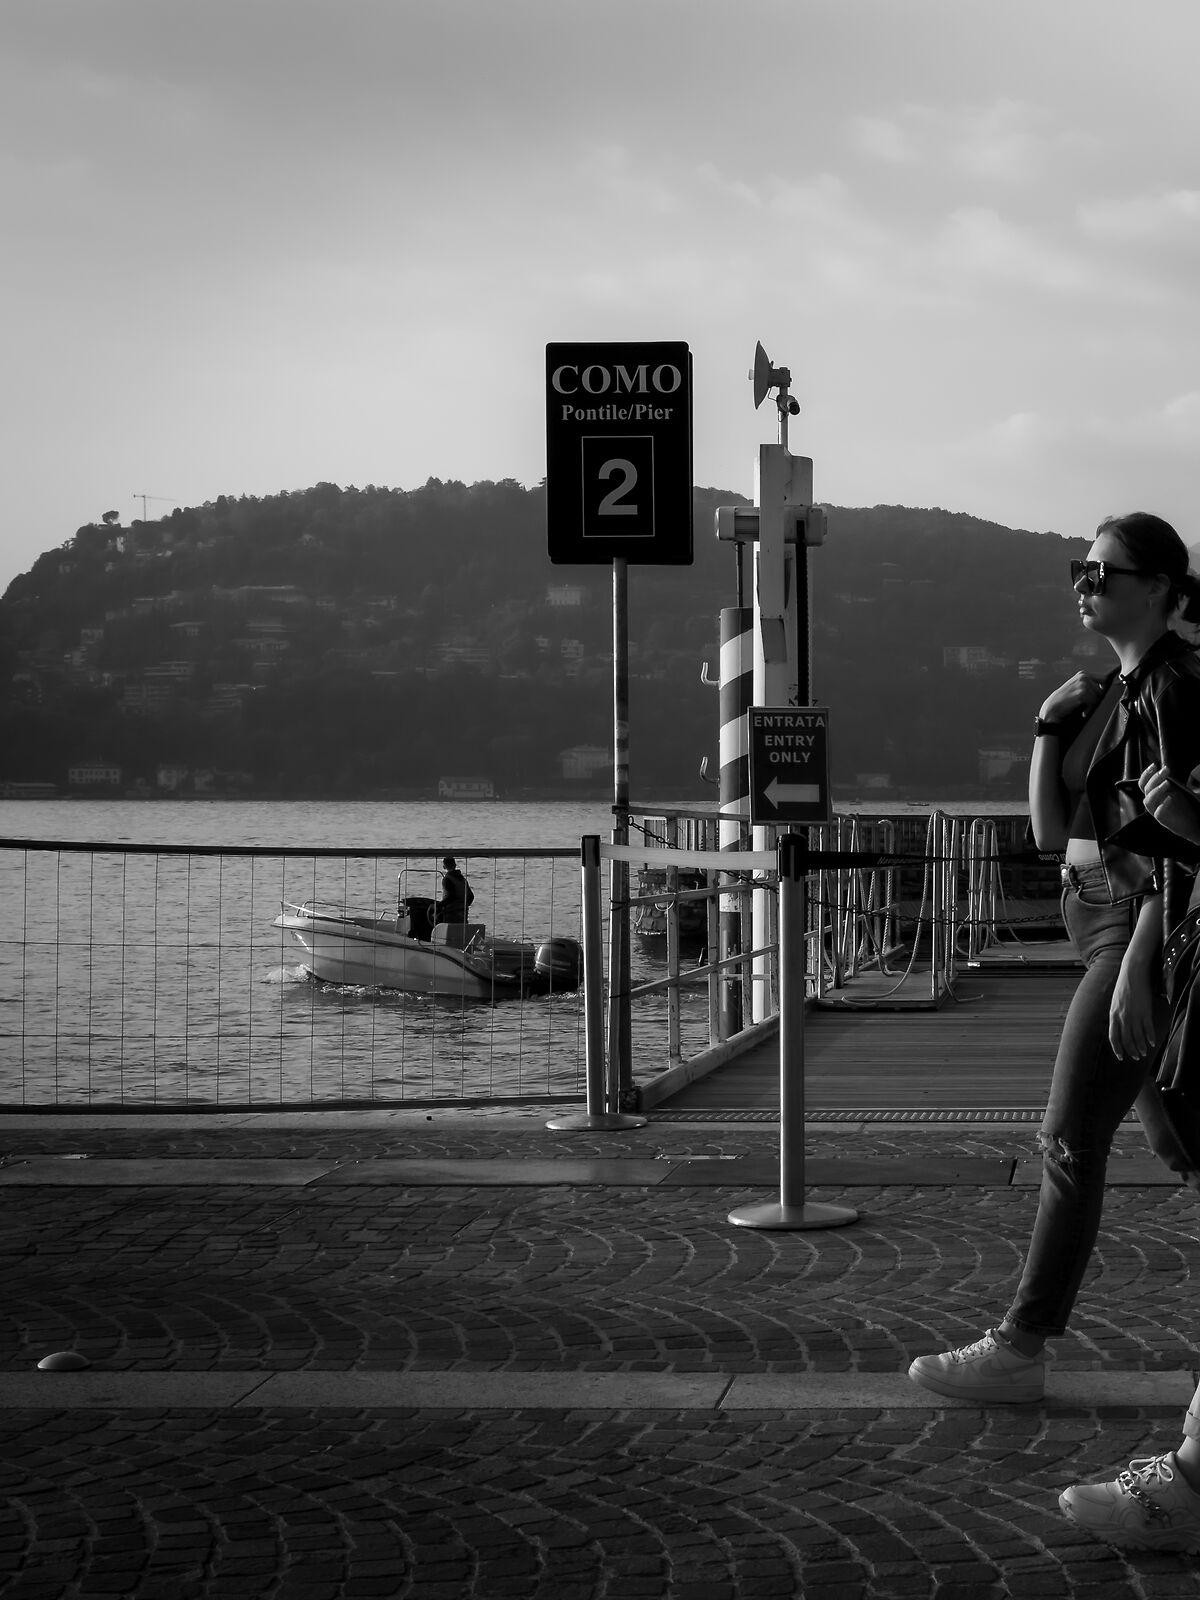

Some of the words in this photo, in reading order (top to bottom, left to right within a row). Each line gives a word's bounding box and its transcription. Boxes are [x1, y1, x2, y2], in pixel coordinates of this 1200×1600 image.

[552, 365, 682, 394] COMO
[562, 404, 674, 421] Pontile/Pier
[598, 458, 638, 515] 2
[754, 716, 825, 728] ENTRATA
[765, 735, 815, 747] ENTRY
[769, 752, 811, 763] ONLY
